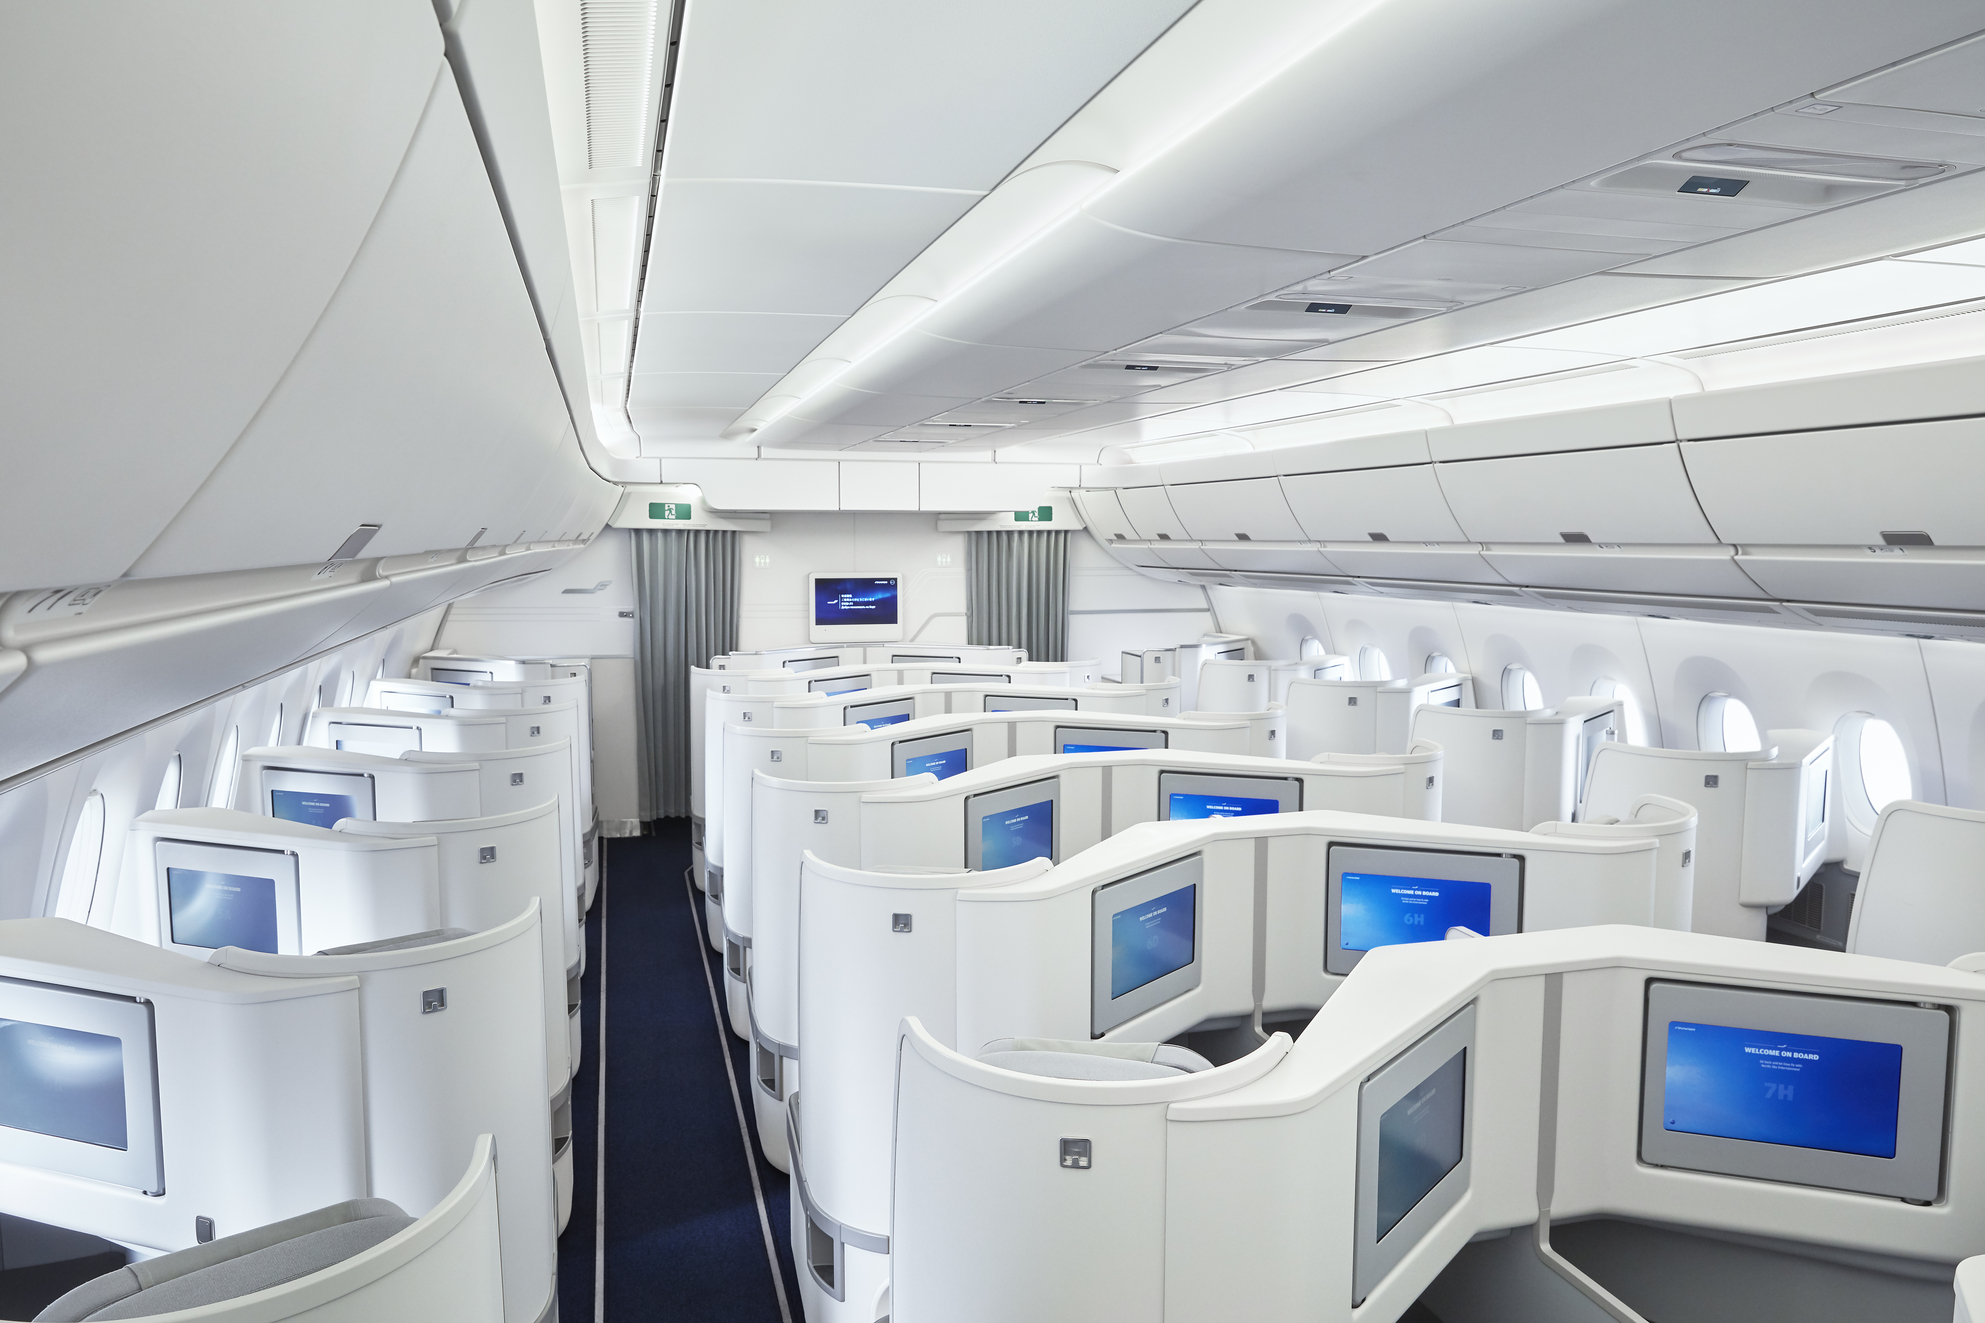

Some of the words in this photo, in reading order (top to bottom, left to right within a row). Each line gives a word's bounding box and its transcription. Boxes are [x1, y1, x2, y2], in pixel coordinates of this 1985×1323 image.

[1404, 912, 1424, 926] 6H
[1146, 935, 1158, 950] 6D
[1744, 1046, 1780, 1056] WELCOME
[1793, 1052, 1820, 1060] BOARD
[1764, 1082, 1794, 1102] 7H
